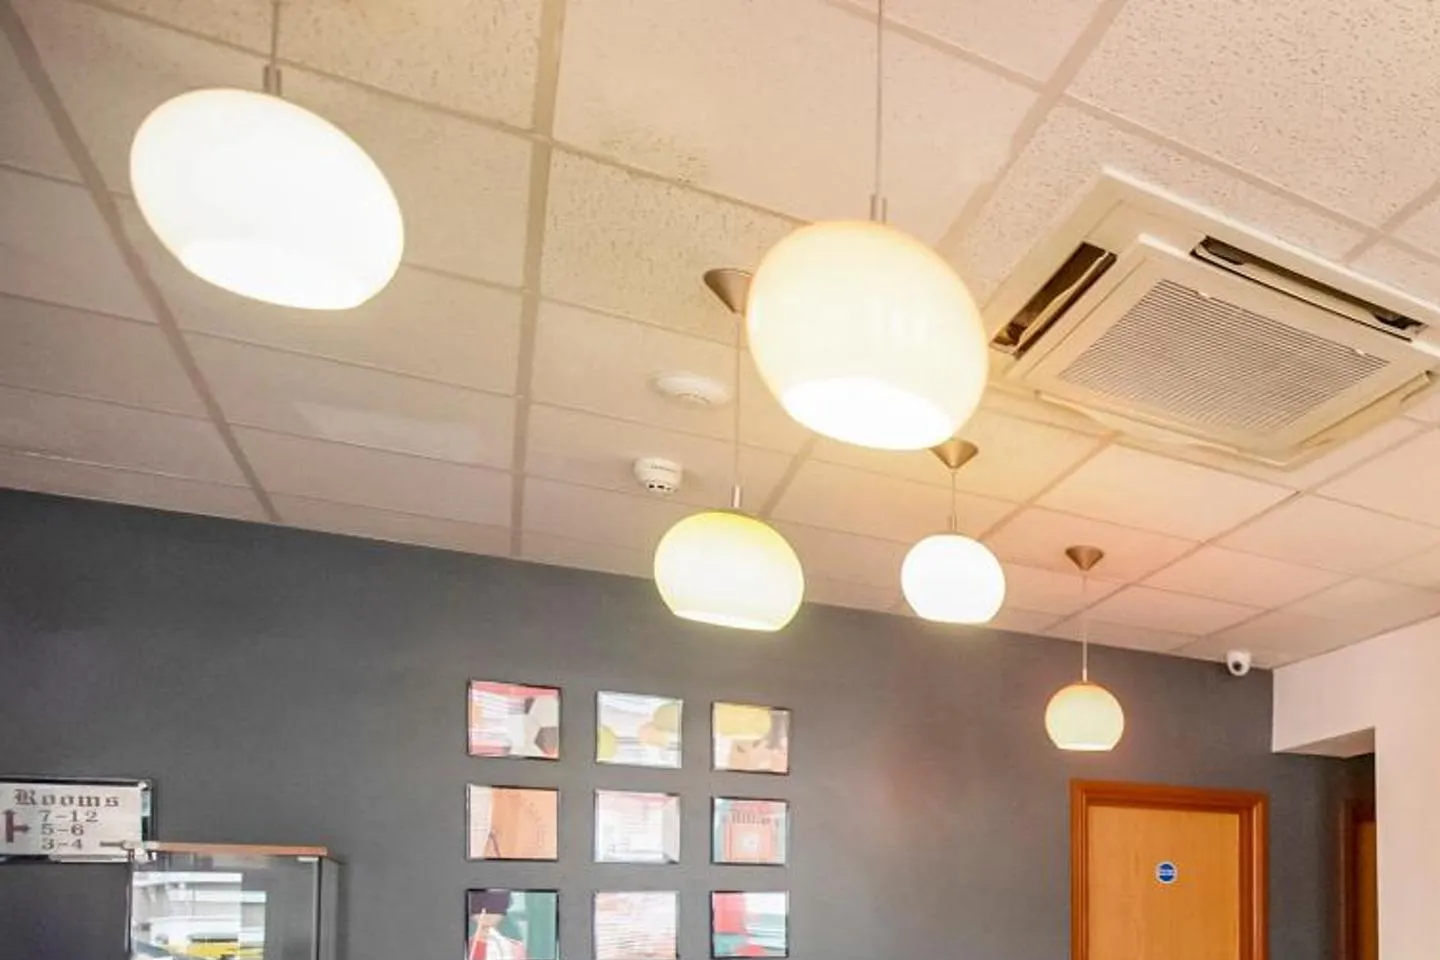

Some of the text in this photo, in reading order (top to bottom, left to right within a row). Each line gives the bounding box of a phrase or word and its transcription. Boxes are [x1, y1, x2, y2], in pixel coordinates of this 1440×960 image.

[14, 789, 119, 807] Rooms
[40, 810, 99, 823] 7-12
[41, 824, 85, 836] 5-6
[41, 838, 83, 850] 3-4
